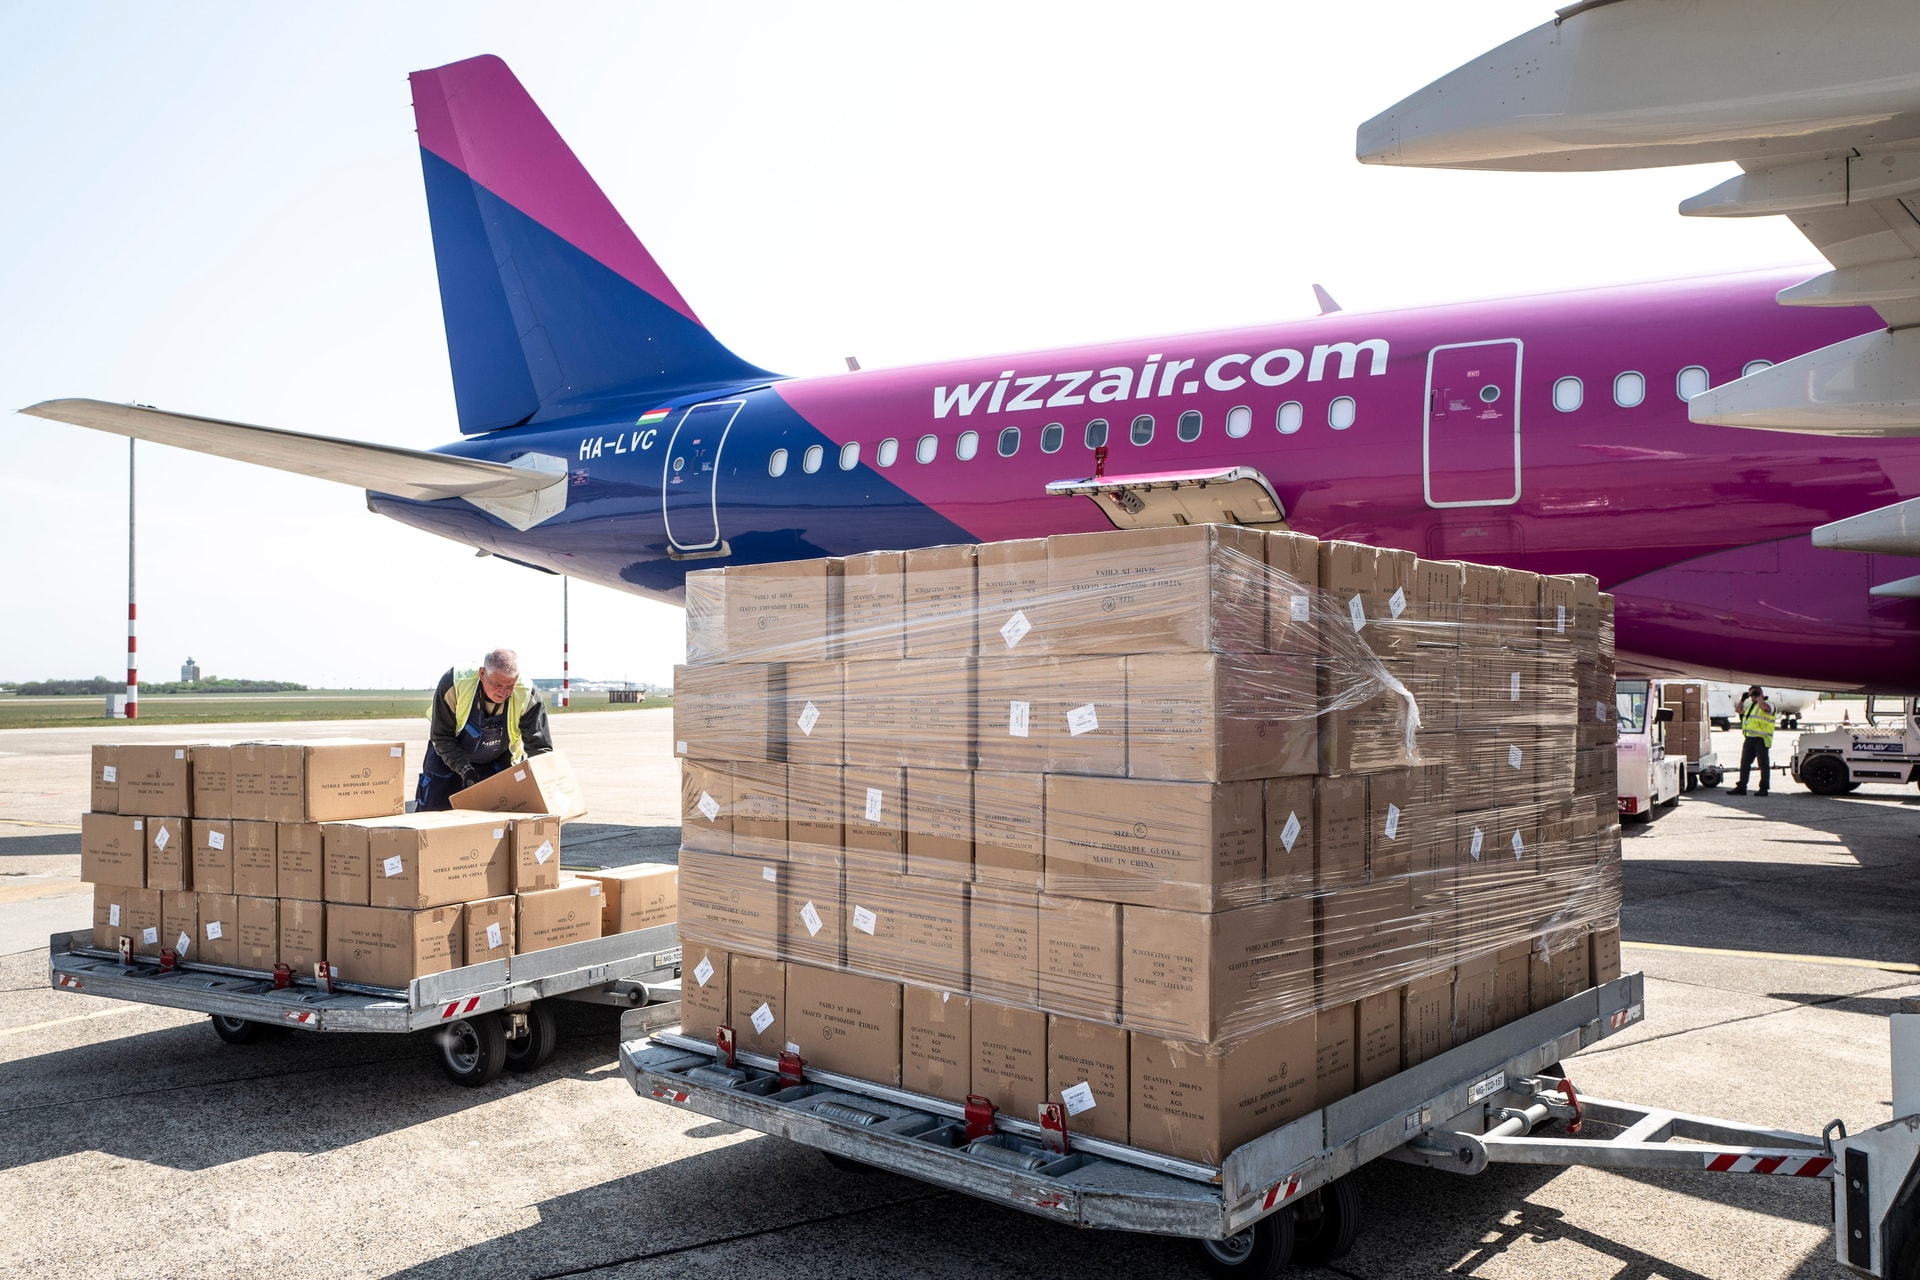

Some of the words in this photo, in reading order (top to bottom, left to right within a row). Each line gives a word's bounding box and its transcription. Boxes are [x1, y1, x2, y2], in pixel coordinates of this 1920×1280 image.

[933, 338, 1390, 419] wizzair.com
[579, 429, 657, 460] HA-LVC
[1069, 840, 1098, 848] NITRILE
[1102, 843, 1146, 853] DISPOSABLE
[1151, 848, 1181, 856] GLOVES
[1093, 856, 1113, 864] MADE
[1130, 860, 1155, 868] CHINA
[552, 925, 574, 933] DISPOSABLE
[819, 1001, 835, 1009] CHINA
[846, 1007, 862, 1015] MADE
[802, 1009, 822, 1018] GLOVES
[823, 1015, 856, 1027] DISPOSABLE
[858, 1022, 880, 1031] NITRILE
[1144, 1074, 1176, 1086] QUANTITY:
[1191, 1084, 1202, 1092] PCS
[1239, 1094, 1258, 1108] NITRILE
[1260, 1085, 1288, 1100] DISPOSABLE
[1289, 1078, 1306, 1090] GLOVES
[1255, 1107, 1269, 1116] MADE
[1270, 1103, 1276, 1111] IN
[1277, 1096, 1292, 1108] CHINA
